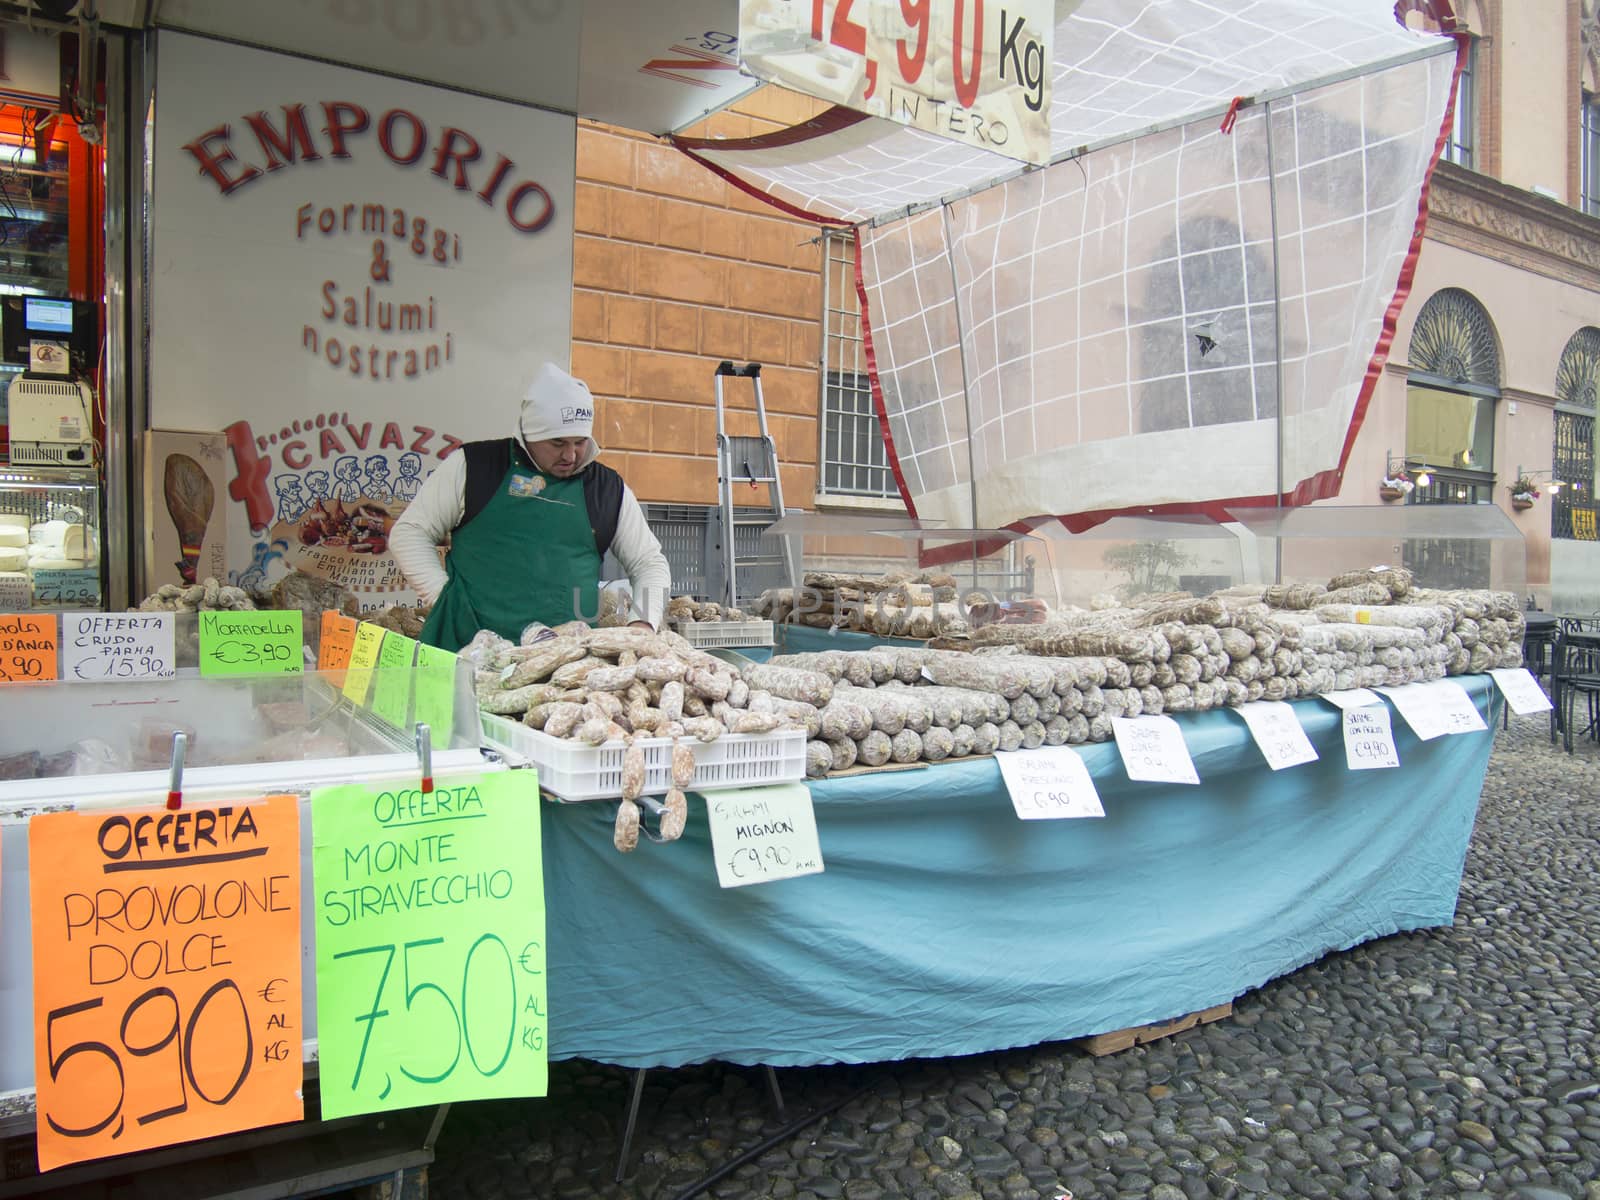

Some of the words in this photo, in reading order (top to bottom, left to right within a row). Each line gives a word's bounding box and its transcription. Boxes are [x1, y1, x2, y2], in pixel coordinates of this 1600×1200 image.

[1000, 8, 1045, 112] Kg
[889, 87, 1010, 146] INTERO
[180, 101, 556, 234] EMPORIO
[296, 201, 461, 263] Formaggi
[370, 238, 391, 282] &
[321, 280, 434, 331] Salumi
[302, 323, 453, 379] nostrani
[298, 545, 345, 565] Franco
[349, 559, 395, 568] Marisa
[316, 560, 376, 576] Emiliano
[329, 571, 376, 585] Manila
[75, 636, 135, 647] CRUDO
[79, 617, 162, 634] OFFERTA
[100, 646, 153, 656] PARMA
[374, 786, 484, 824] OFFERTA
[736, 816, 794, 840] MIGNON
[97, 807, 258, 860] OFFERTA
[344, 833, 458, 881] MONTE
[63, 875, 292, 941] PROVOLONE
[324, 869, 513, 927] STRAVECCHIO
[89, 934, 233, 985] DOLCE
[266, 1014, 292, 1030] AL
[333, 932, 517, 1100] 7,50
[524, 996, 547, 1017] AL
[46, 978, 254, 1140] 5,90
[264, 1040, 290, 1063] KG
[522, 1026, 543, 1052] KG
